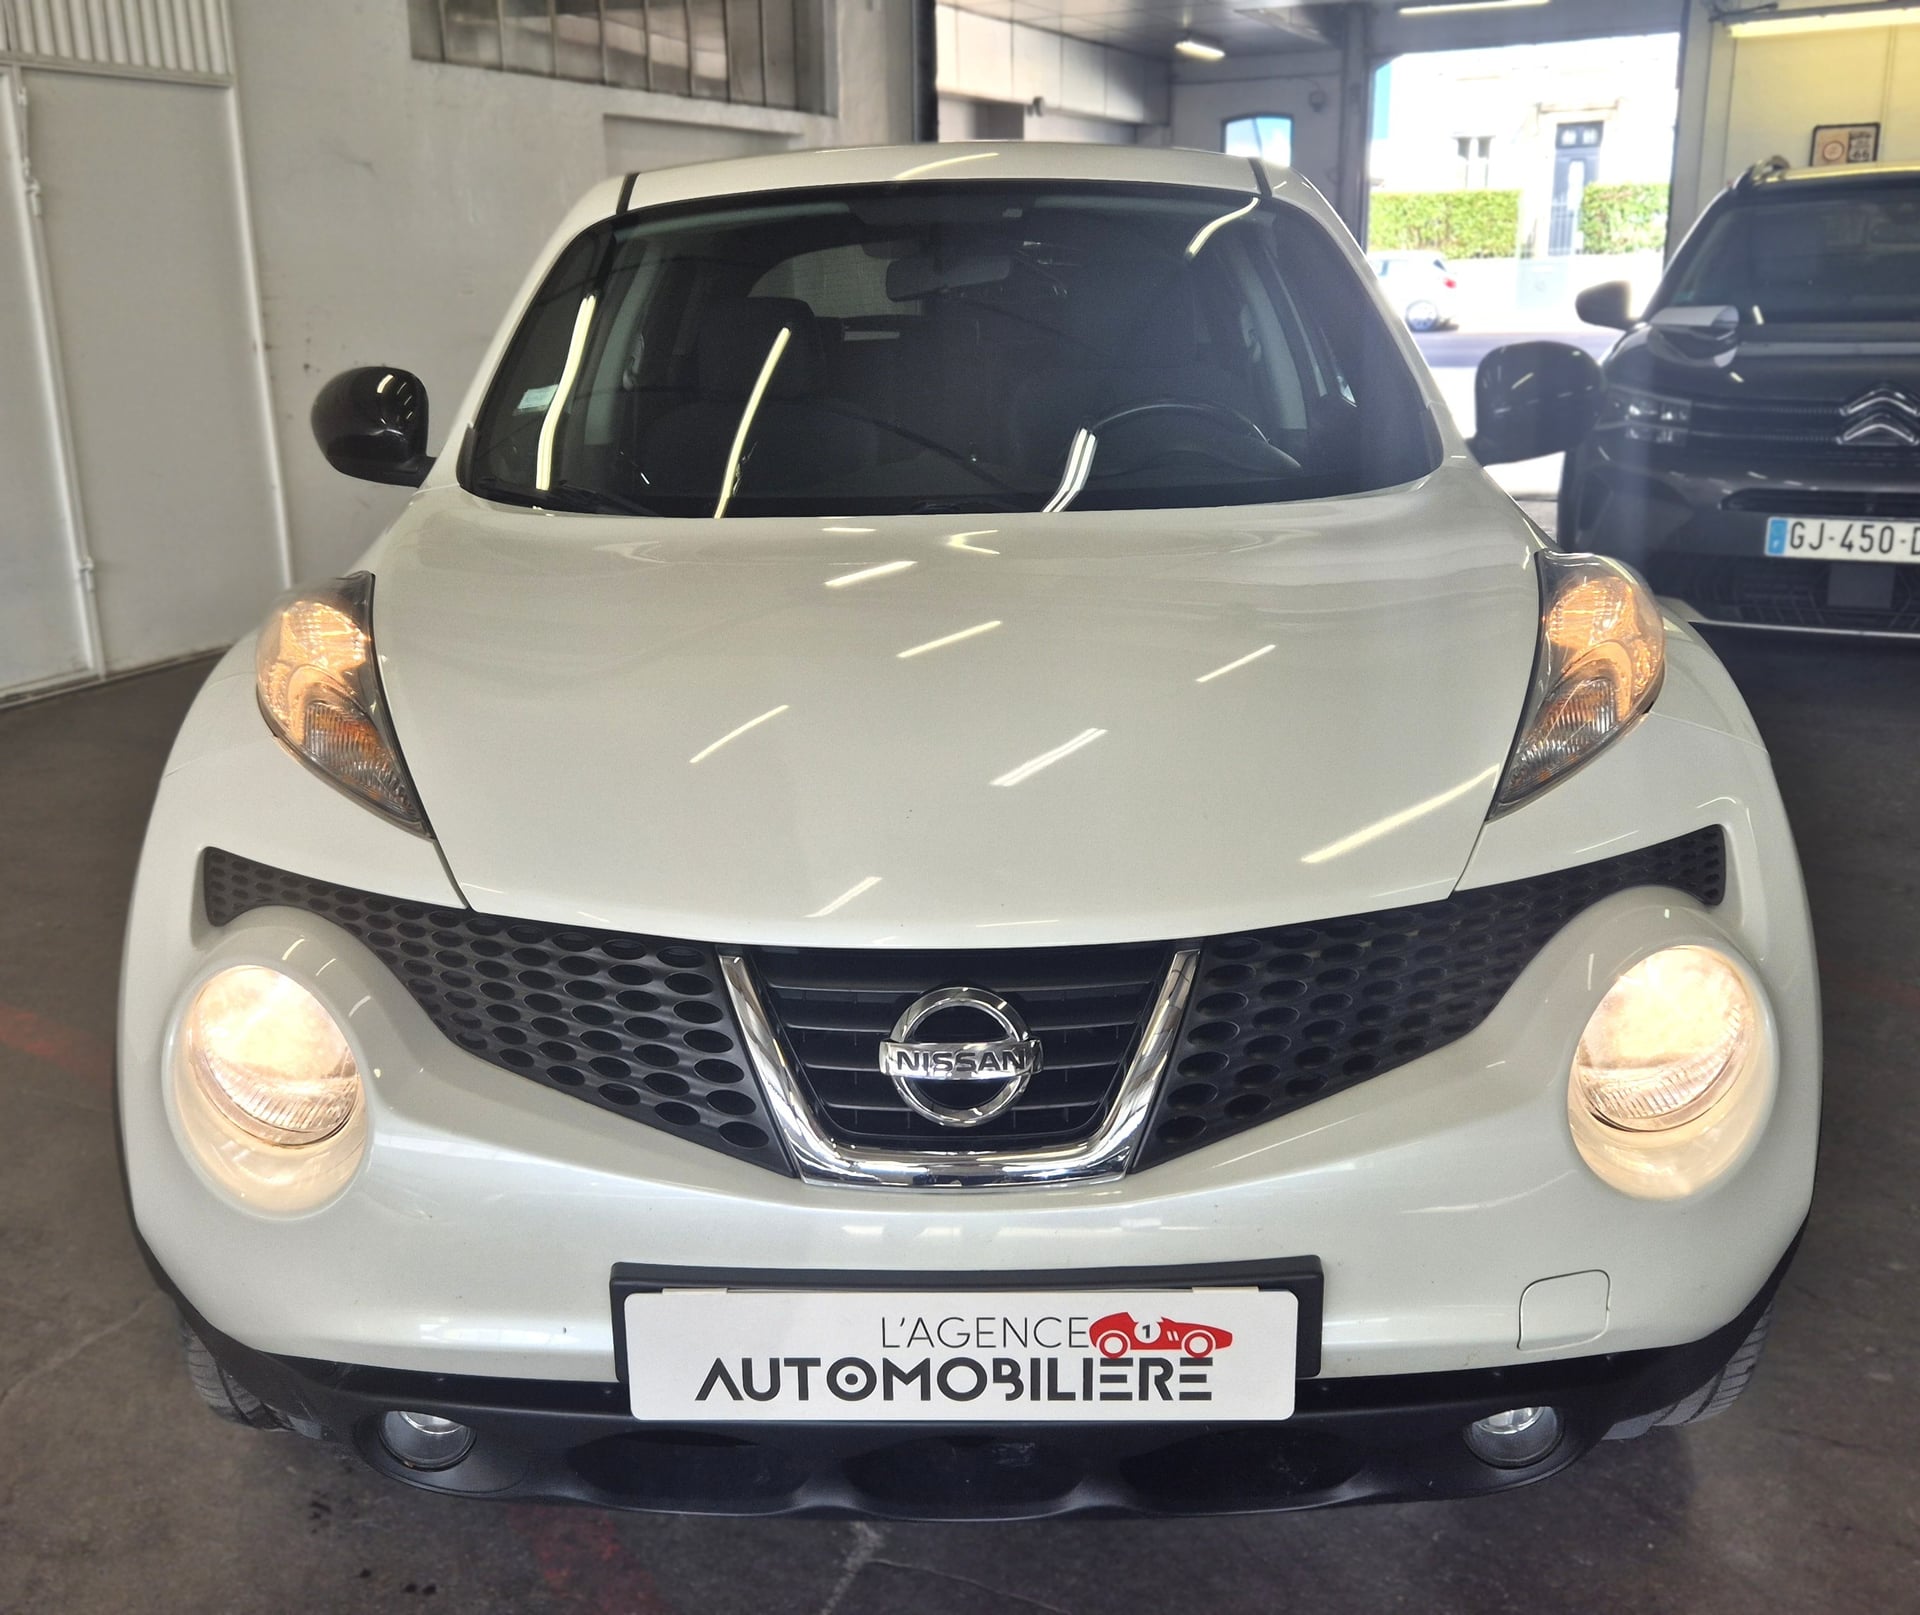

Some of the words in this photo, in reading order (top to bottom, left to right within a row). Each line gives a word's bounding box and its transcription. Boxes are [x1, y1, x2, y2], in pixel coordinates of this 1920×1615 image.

[897, 1050, 1025, 1072] NISSAN
[882, 1316, 1089, 1349] L'AGENCE
[1142, 1324, 1151, 1339] 1
